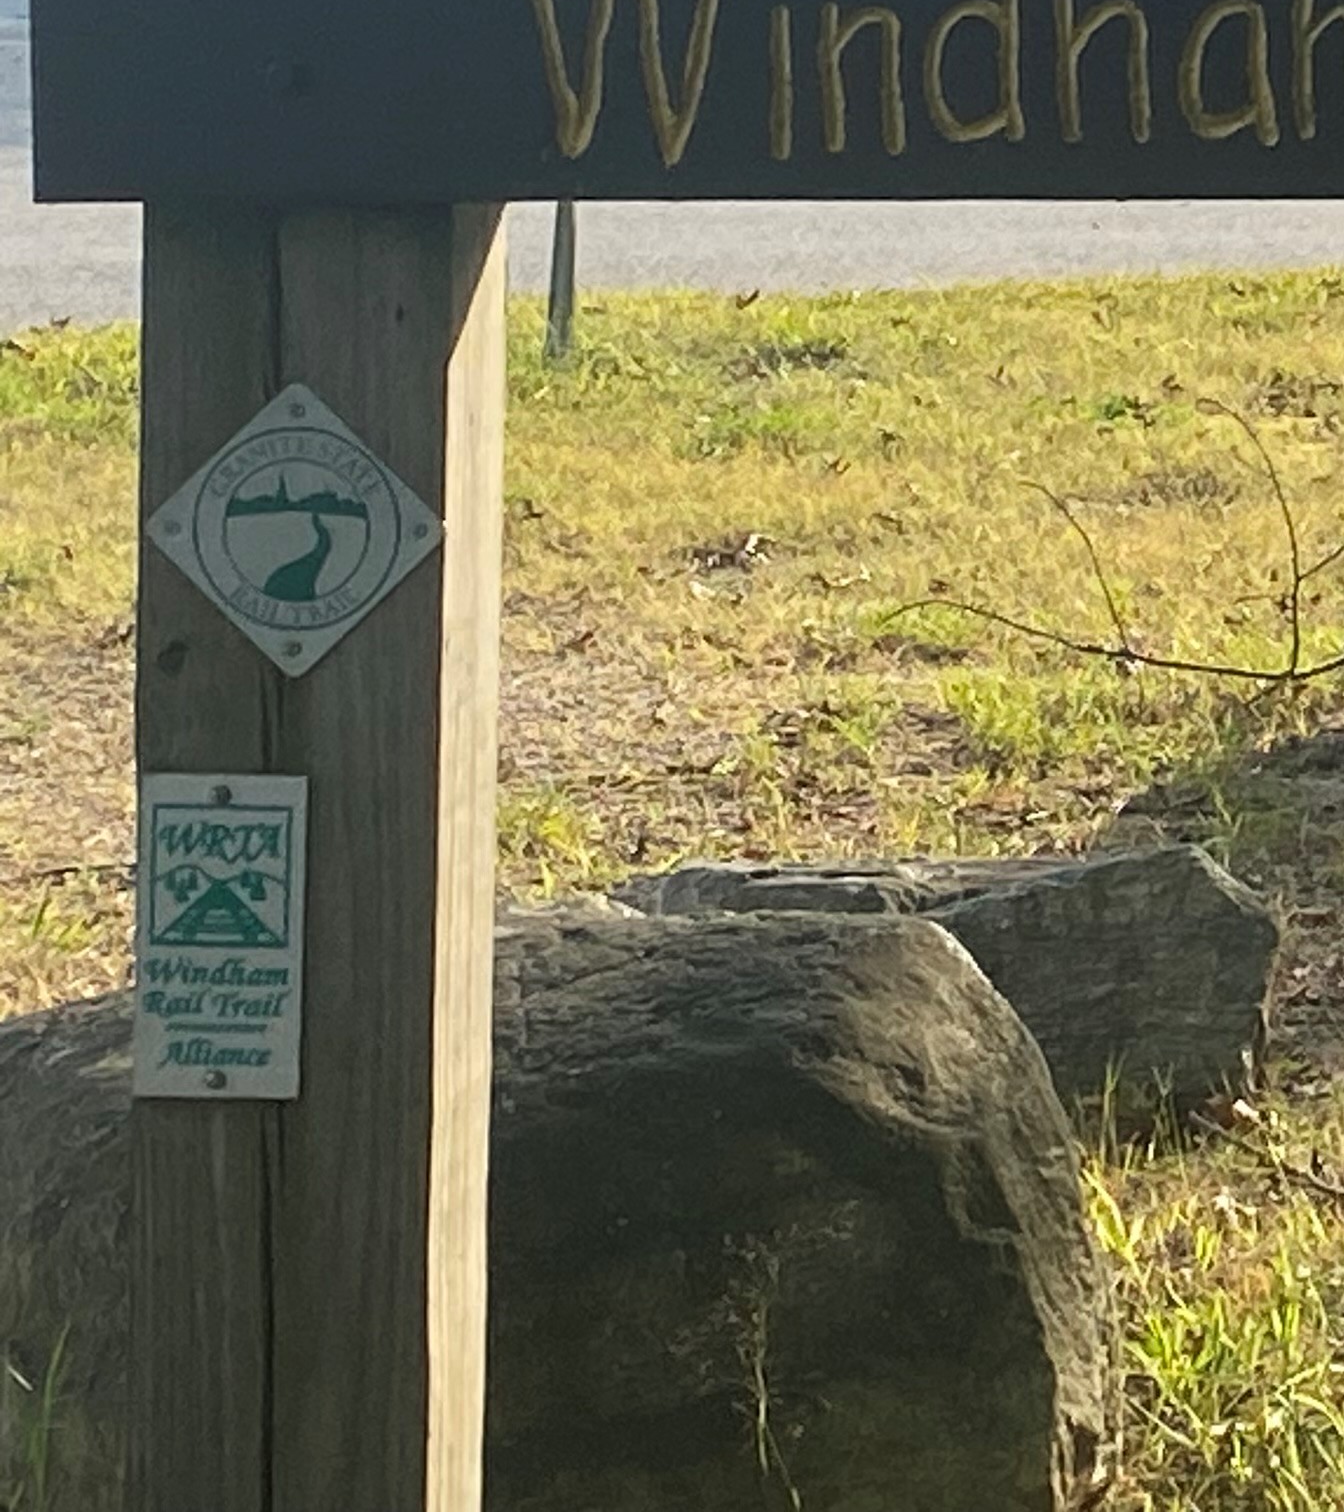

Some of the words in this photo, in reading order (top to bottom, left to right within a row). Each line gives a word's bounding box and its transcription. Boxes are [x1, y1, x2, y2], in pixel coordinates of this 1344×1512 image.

[145, 956, 290, 986] Windham
[143, 988, 210, 1017] Rail
[212, 989, 291, 1018] Trail
[158, 1038, 273, 1070] Alliance
